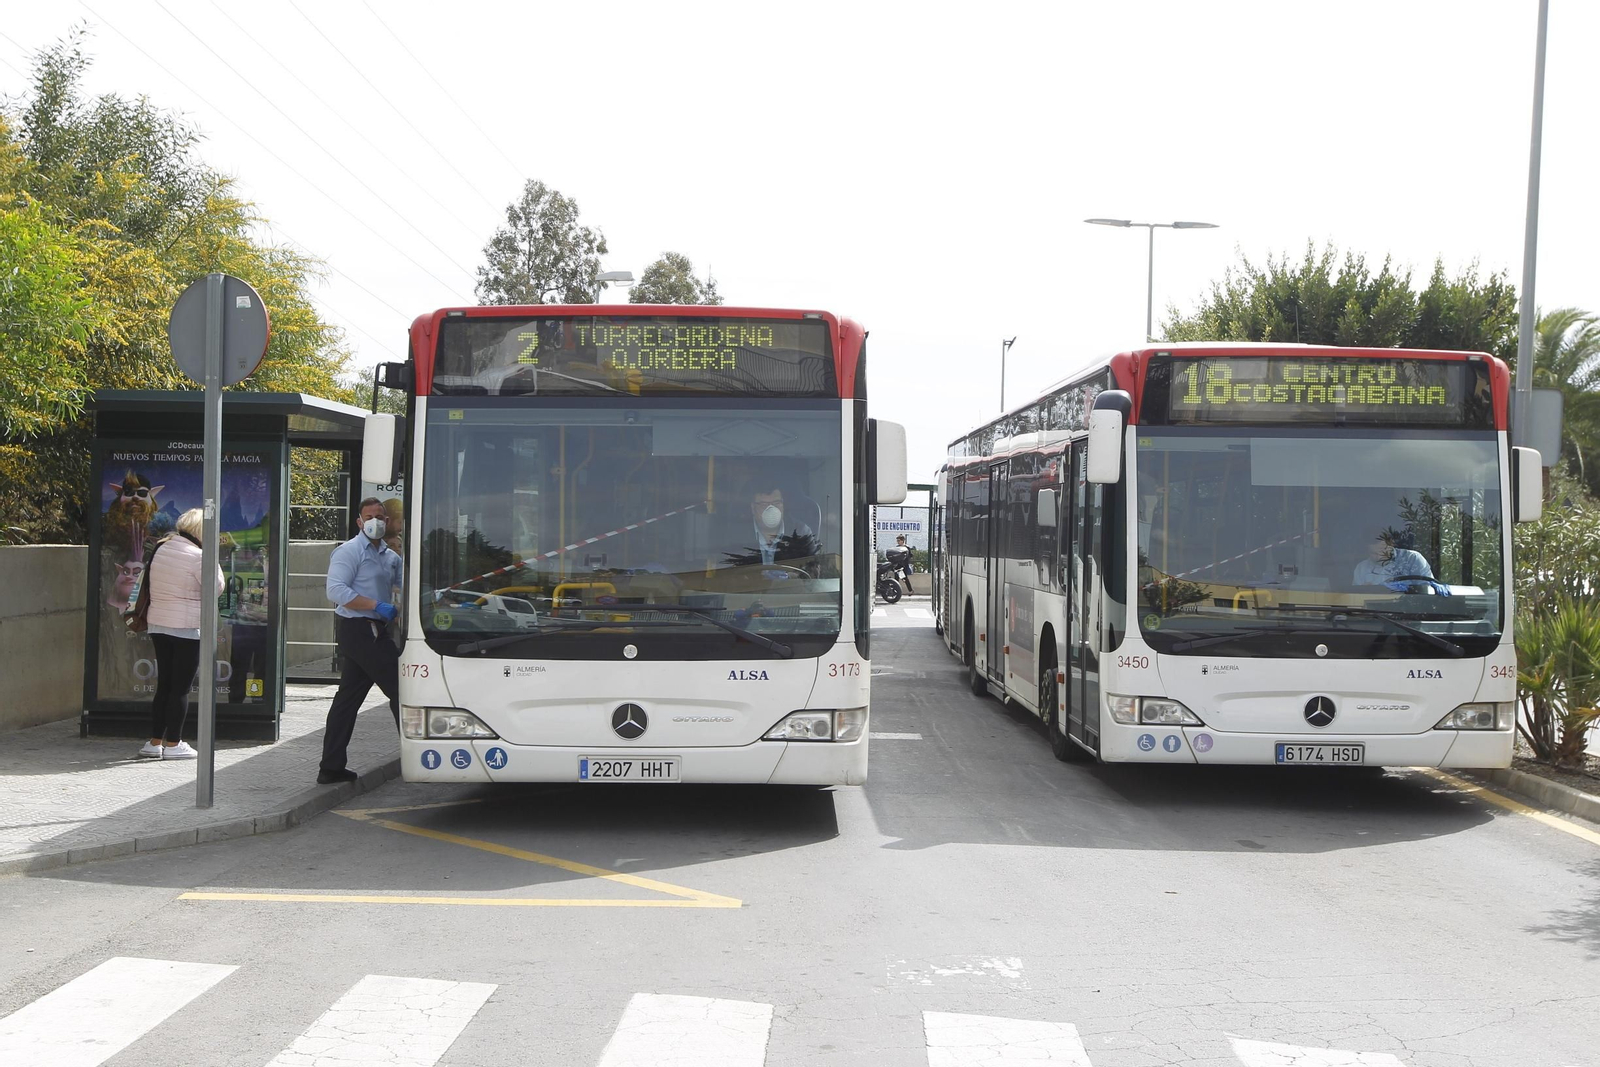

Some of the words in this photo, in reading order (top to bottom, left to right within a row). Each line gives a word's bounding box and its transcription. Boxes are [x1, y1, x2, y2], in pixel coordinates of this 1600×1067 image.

[575, 325, 773, 347] TORRECARDENA
[517, 332, 539, 364] 2
[612, 348, 736, 370] O.ORBERA
[1283, 364, 1396, 384] CENTRO
[1183, 362, 1233, 405] 18
[1233, 384, 1446, 405] COSTACABANA
[113, 453, 150, 461] NUEVOS
[153, 453, 191, 462] TIEMPOS
[232, 455, 261, 463] MAGIA
[890, 522, 921, 532] ENCUENTRO
[401, 662, 430, 678] 3173
[828, 662, 861, 677] 3173
[1117, 655, 1150, 669] 3450
[727, 669, 770, 681] ALSA
[1406, 669, 1444, 679] ALSA
[1285, 746, 1324, 761] 6174
[1332, 747, 1360, 762] HSD
[592, 762, 633, 778] 2207
[641, 762, 674, 778] HHT
